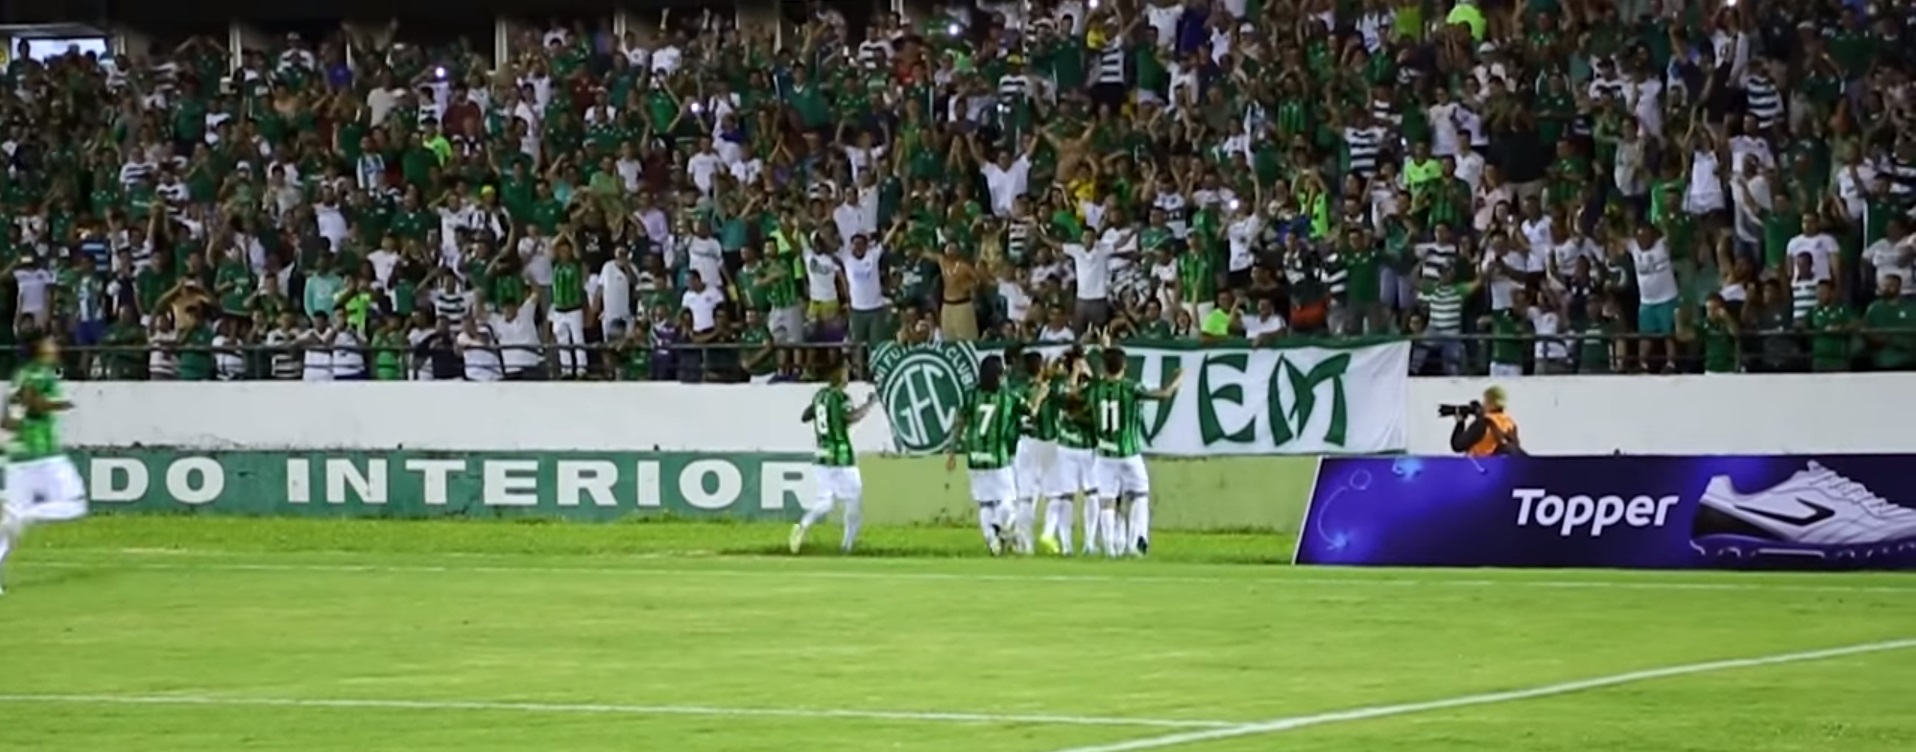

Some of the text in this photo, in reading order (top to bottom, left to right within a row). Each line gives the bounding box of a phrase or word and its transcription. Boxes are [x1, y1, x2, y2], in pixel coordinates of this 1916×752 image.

[816, 403, 829, 434] 8
[977, 403, 996, 436] 7
[1100, 399, 1120, 432] 11
[90, 457, 820, 510] DO INTERIOR
[1512, 488, 1680, 536] Topper
